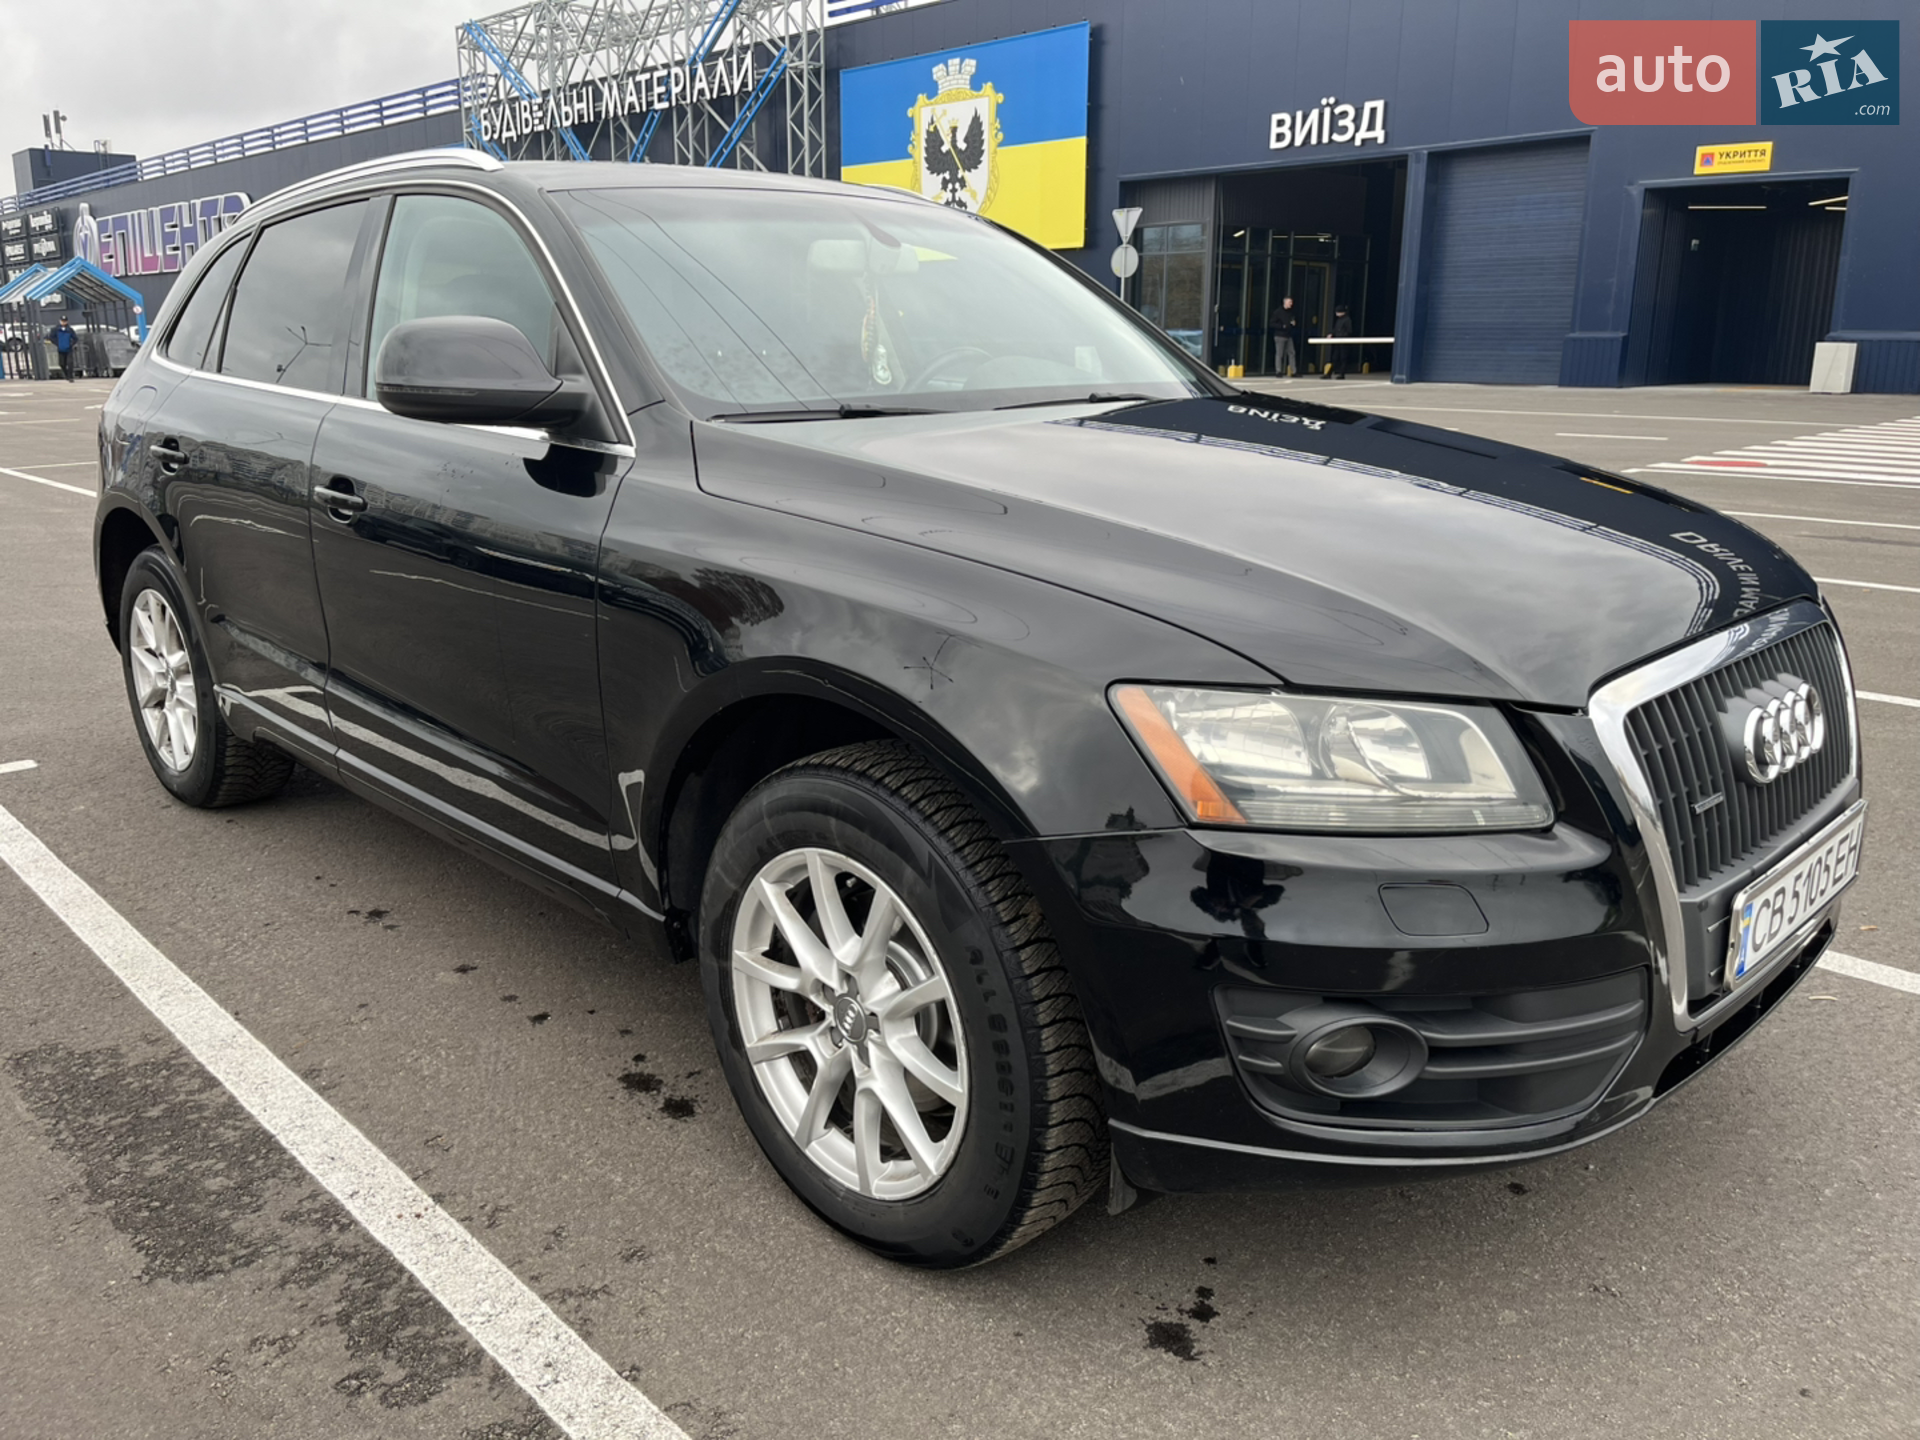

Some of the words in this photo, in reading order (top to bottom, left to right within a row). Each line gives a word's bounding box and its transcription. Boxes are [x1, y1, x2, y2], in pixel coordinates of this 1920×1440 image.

[480, 86, 594, 144] БУДІВЕЛЬНІ
[601, 50, 754, 119] МАТЕРІАЛИ
[1269, 96, 1386, 149] ВИЇЗД
[1718, 148, 1767, 160] УКРИТТЯ
[1751, 886, 1786, 952] CB
[1788, 845, 1834, 925] 5105
[1832, 822, 1862, 888] EH
